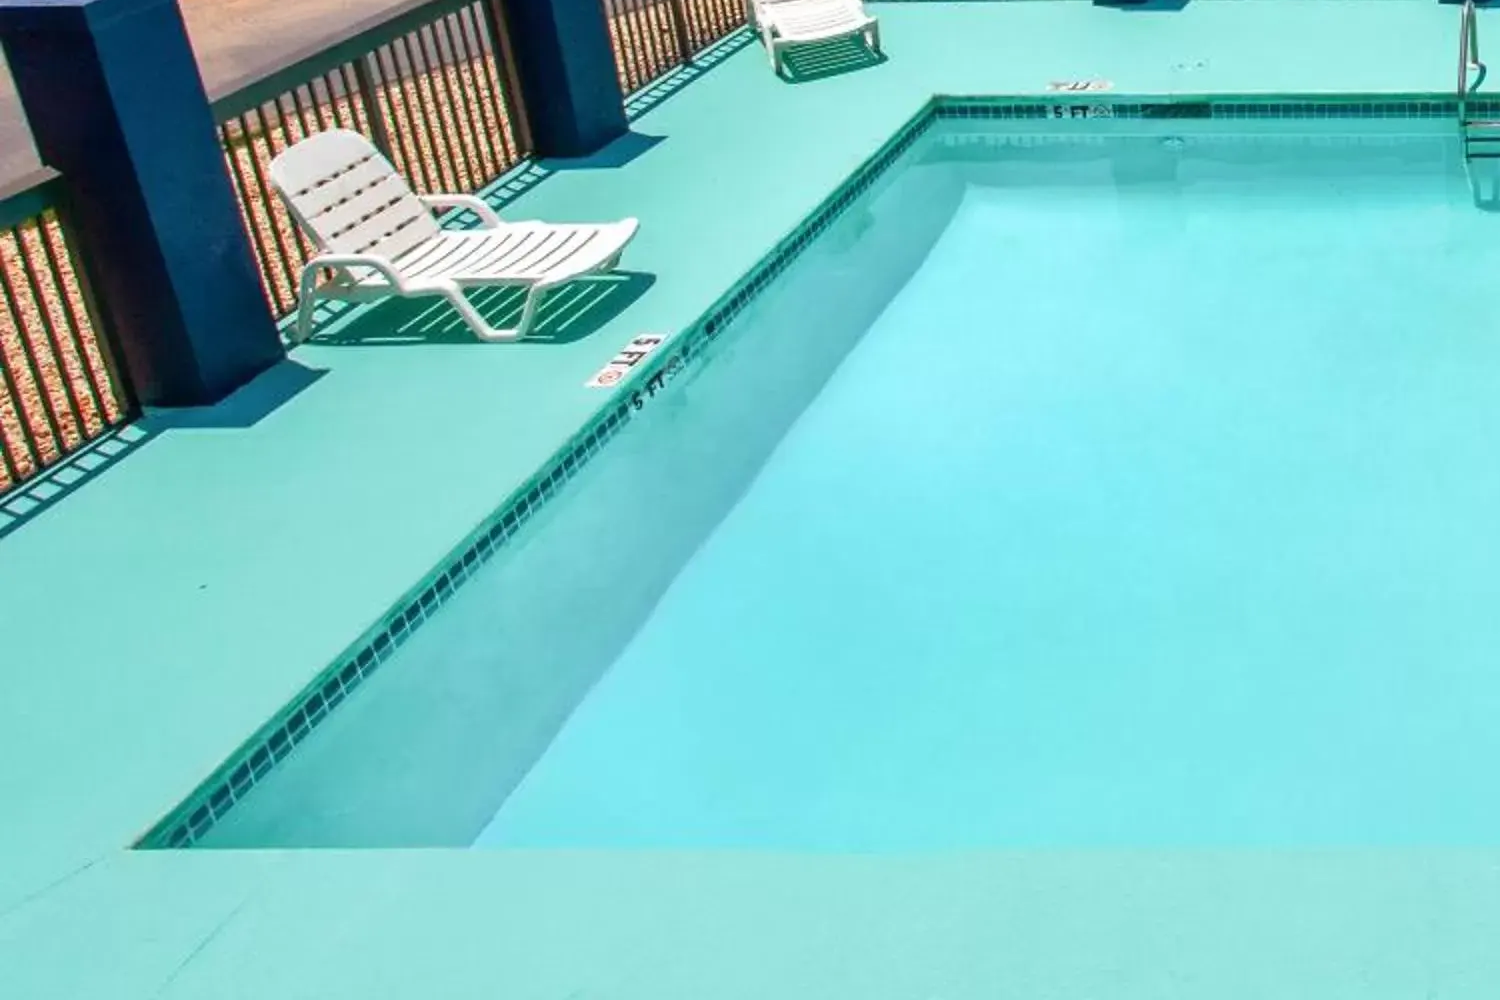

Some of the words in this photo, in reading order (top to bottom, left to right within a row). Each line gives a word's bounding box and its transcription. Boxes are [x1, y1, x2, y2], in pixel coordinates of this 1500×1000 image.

[1053, 105, 1063, 118] 5
[1070, 105, 1089, 118] FT
[611, 351, 648, 367] FT
[631, 391, 643, 411] 5
[645, 369, 664, 397] FT
